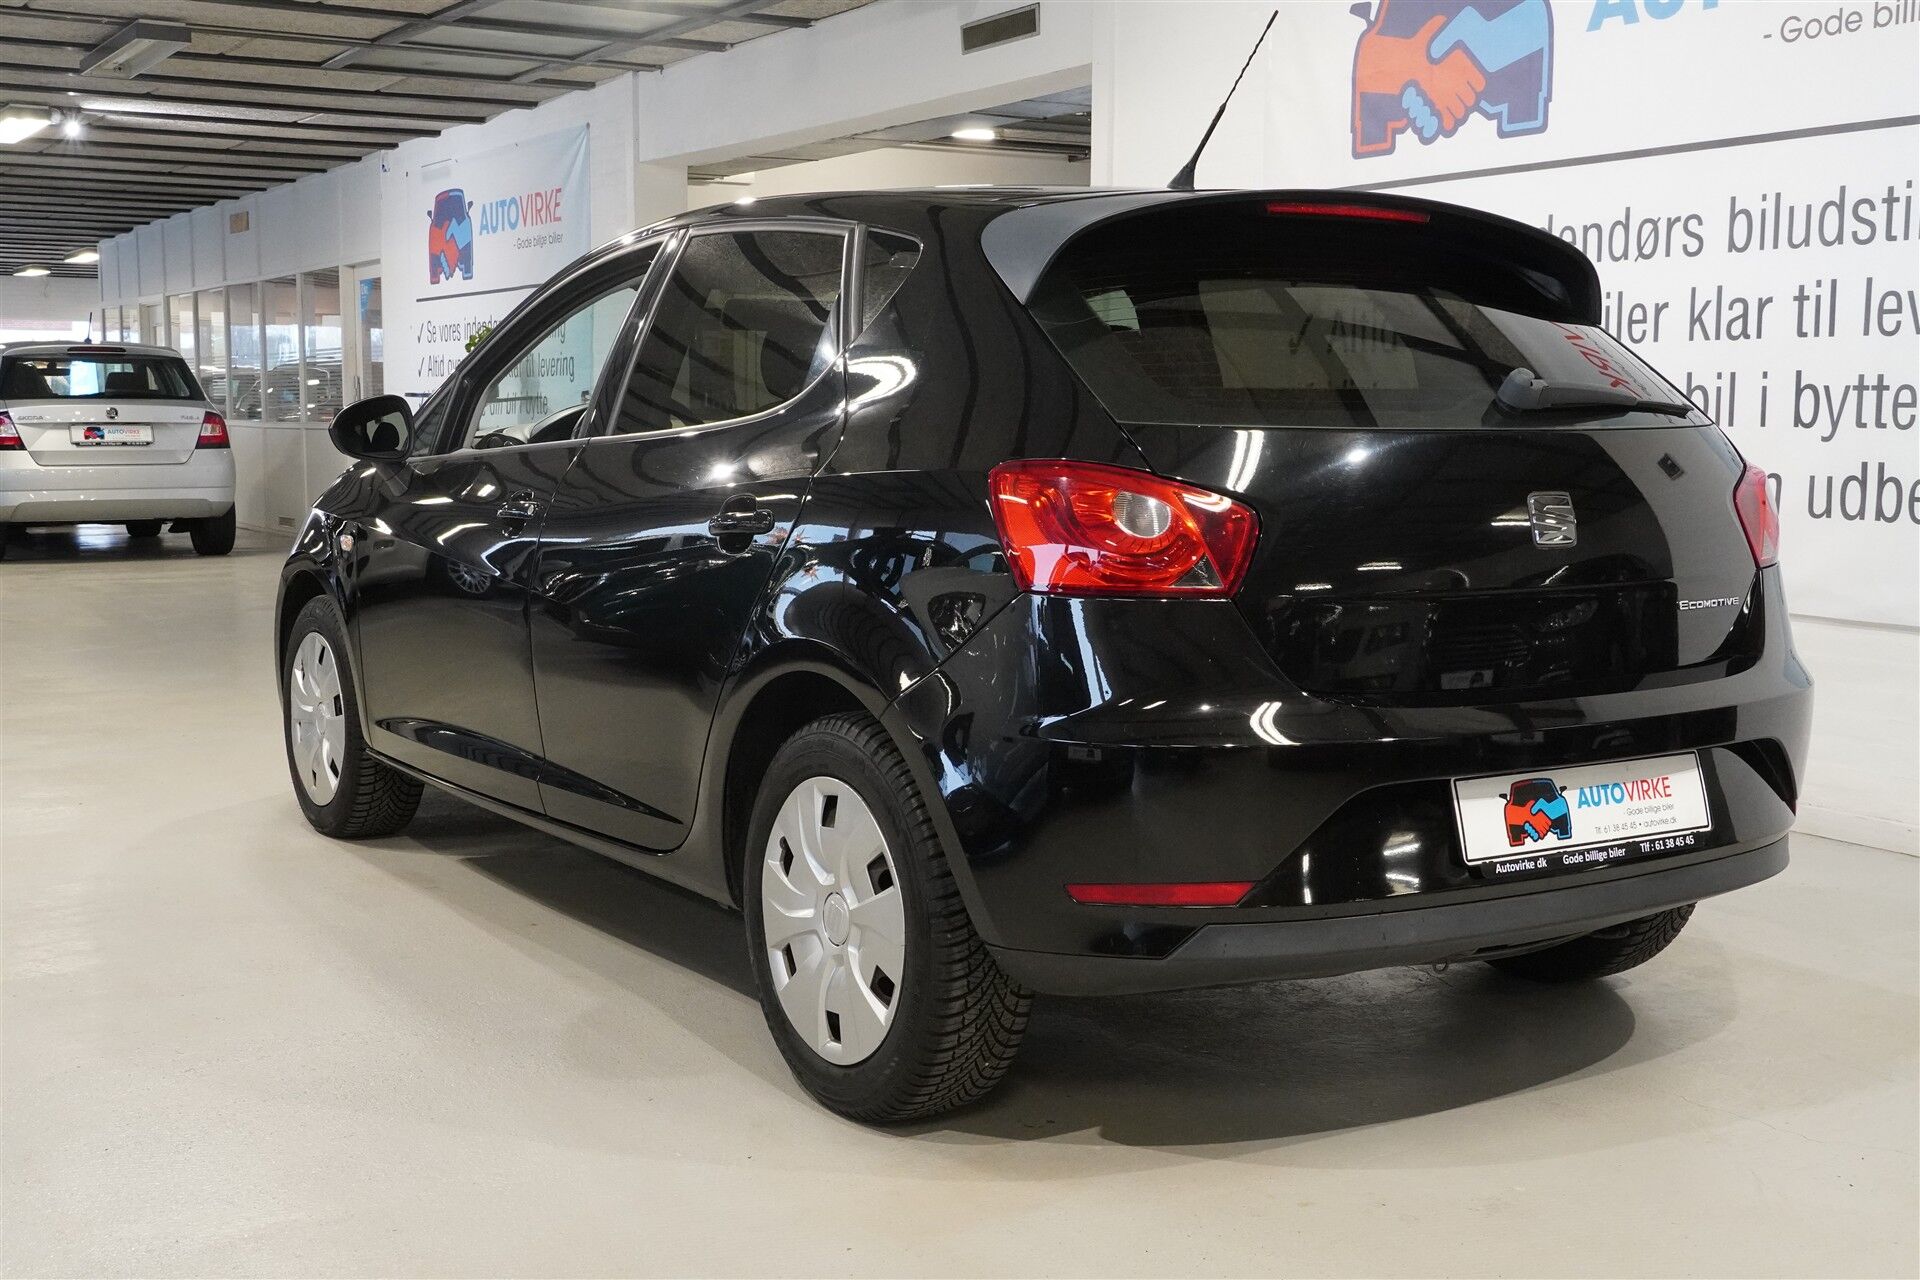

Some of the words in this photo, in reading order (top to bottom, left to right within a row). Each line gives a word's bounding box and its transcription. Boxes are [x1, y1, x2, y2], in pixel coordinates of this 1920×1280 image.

[1780, 8, 1863, 43] Gode
[1873, 0, 1919, 28] bill
[479, 187, 562, 236] AUTOVIRKE
[1539, 207, 1704, 262] endørs
[1727, 180, 1919, 253] biludsti
[427, 320, 437, 344] Se
[439, 323, 461, 342] vores
[1604, 290, 1669, 345] iler
[1689, 285, 1773, 341] klar
[1793, 279, 1838, 338] til
[427, 354, 445, 377] Altid
[537, 352, 575, 383] levering
[1760, 371, 1768, 428] i
[1793, 370, 1918, 443] bytte
[1577, 776, 1672, 809] AUTOVIRKE
[1495, 860, 1536, 874] Autovirke
[1536, 857, 1548, 868] dk
[1562, 853, 1584, 865] Gode
[1584, 849, 1608, 862] billige
[1608, 847, 1626, 858] biler
[1655, 840, 1664, 851] 61
[1665, 838, 1674, 849] 38
[1675, 836, 1685, 847] 45
[1685, 835, 1695, 846] 45
